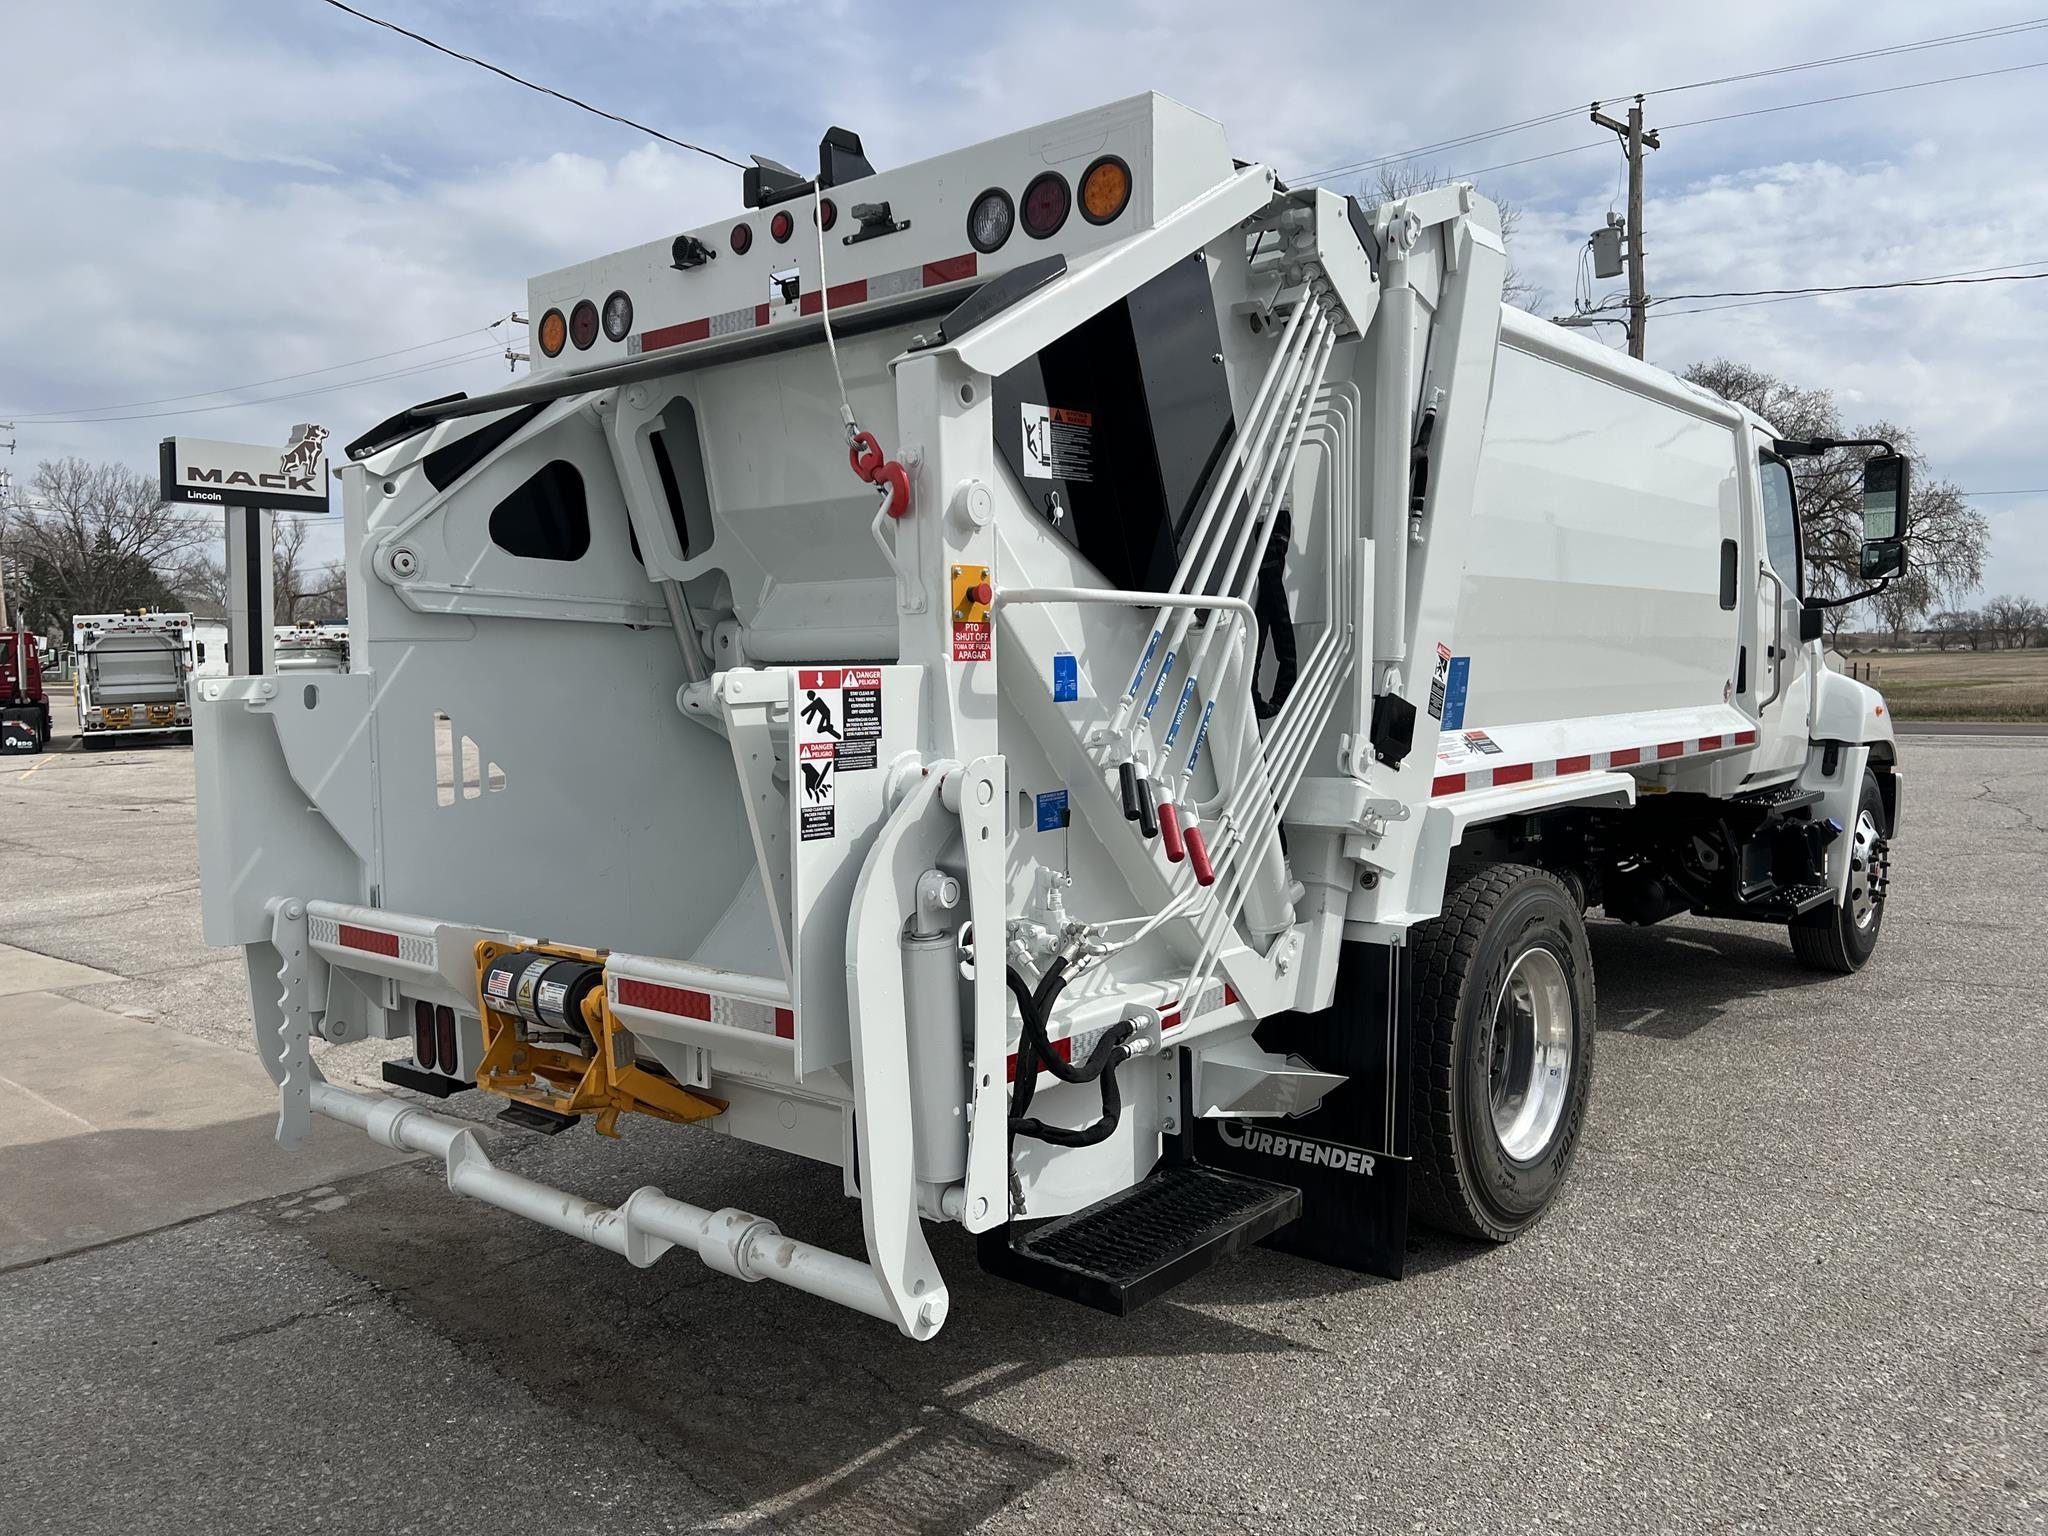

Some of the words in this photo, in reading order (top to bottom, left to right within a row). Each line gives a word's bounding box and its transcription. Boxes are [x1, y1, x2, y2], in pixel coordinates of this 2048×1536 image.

[187, 466, 317, 492] MACK
[187, 490, 222, 501] Lincoln
[965, 624, 979, 632] PTO
[955, 632, 974, 641] SHUT
[975, 632, 989, 641] OFF
[958, 650, 987, 659] APAGAR
[856, 671, 881, 679] DANGER
[1155, 672, 1169, 696] SWEEP
[1175, 699, 1189, 725] WINCH
[811, 750, 833, 758] PELIGRO
[1217, 1116, 1377, 1177] CURBTENDER
